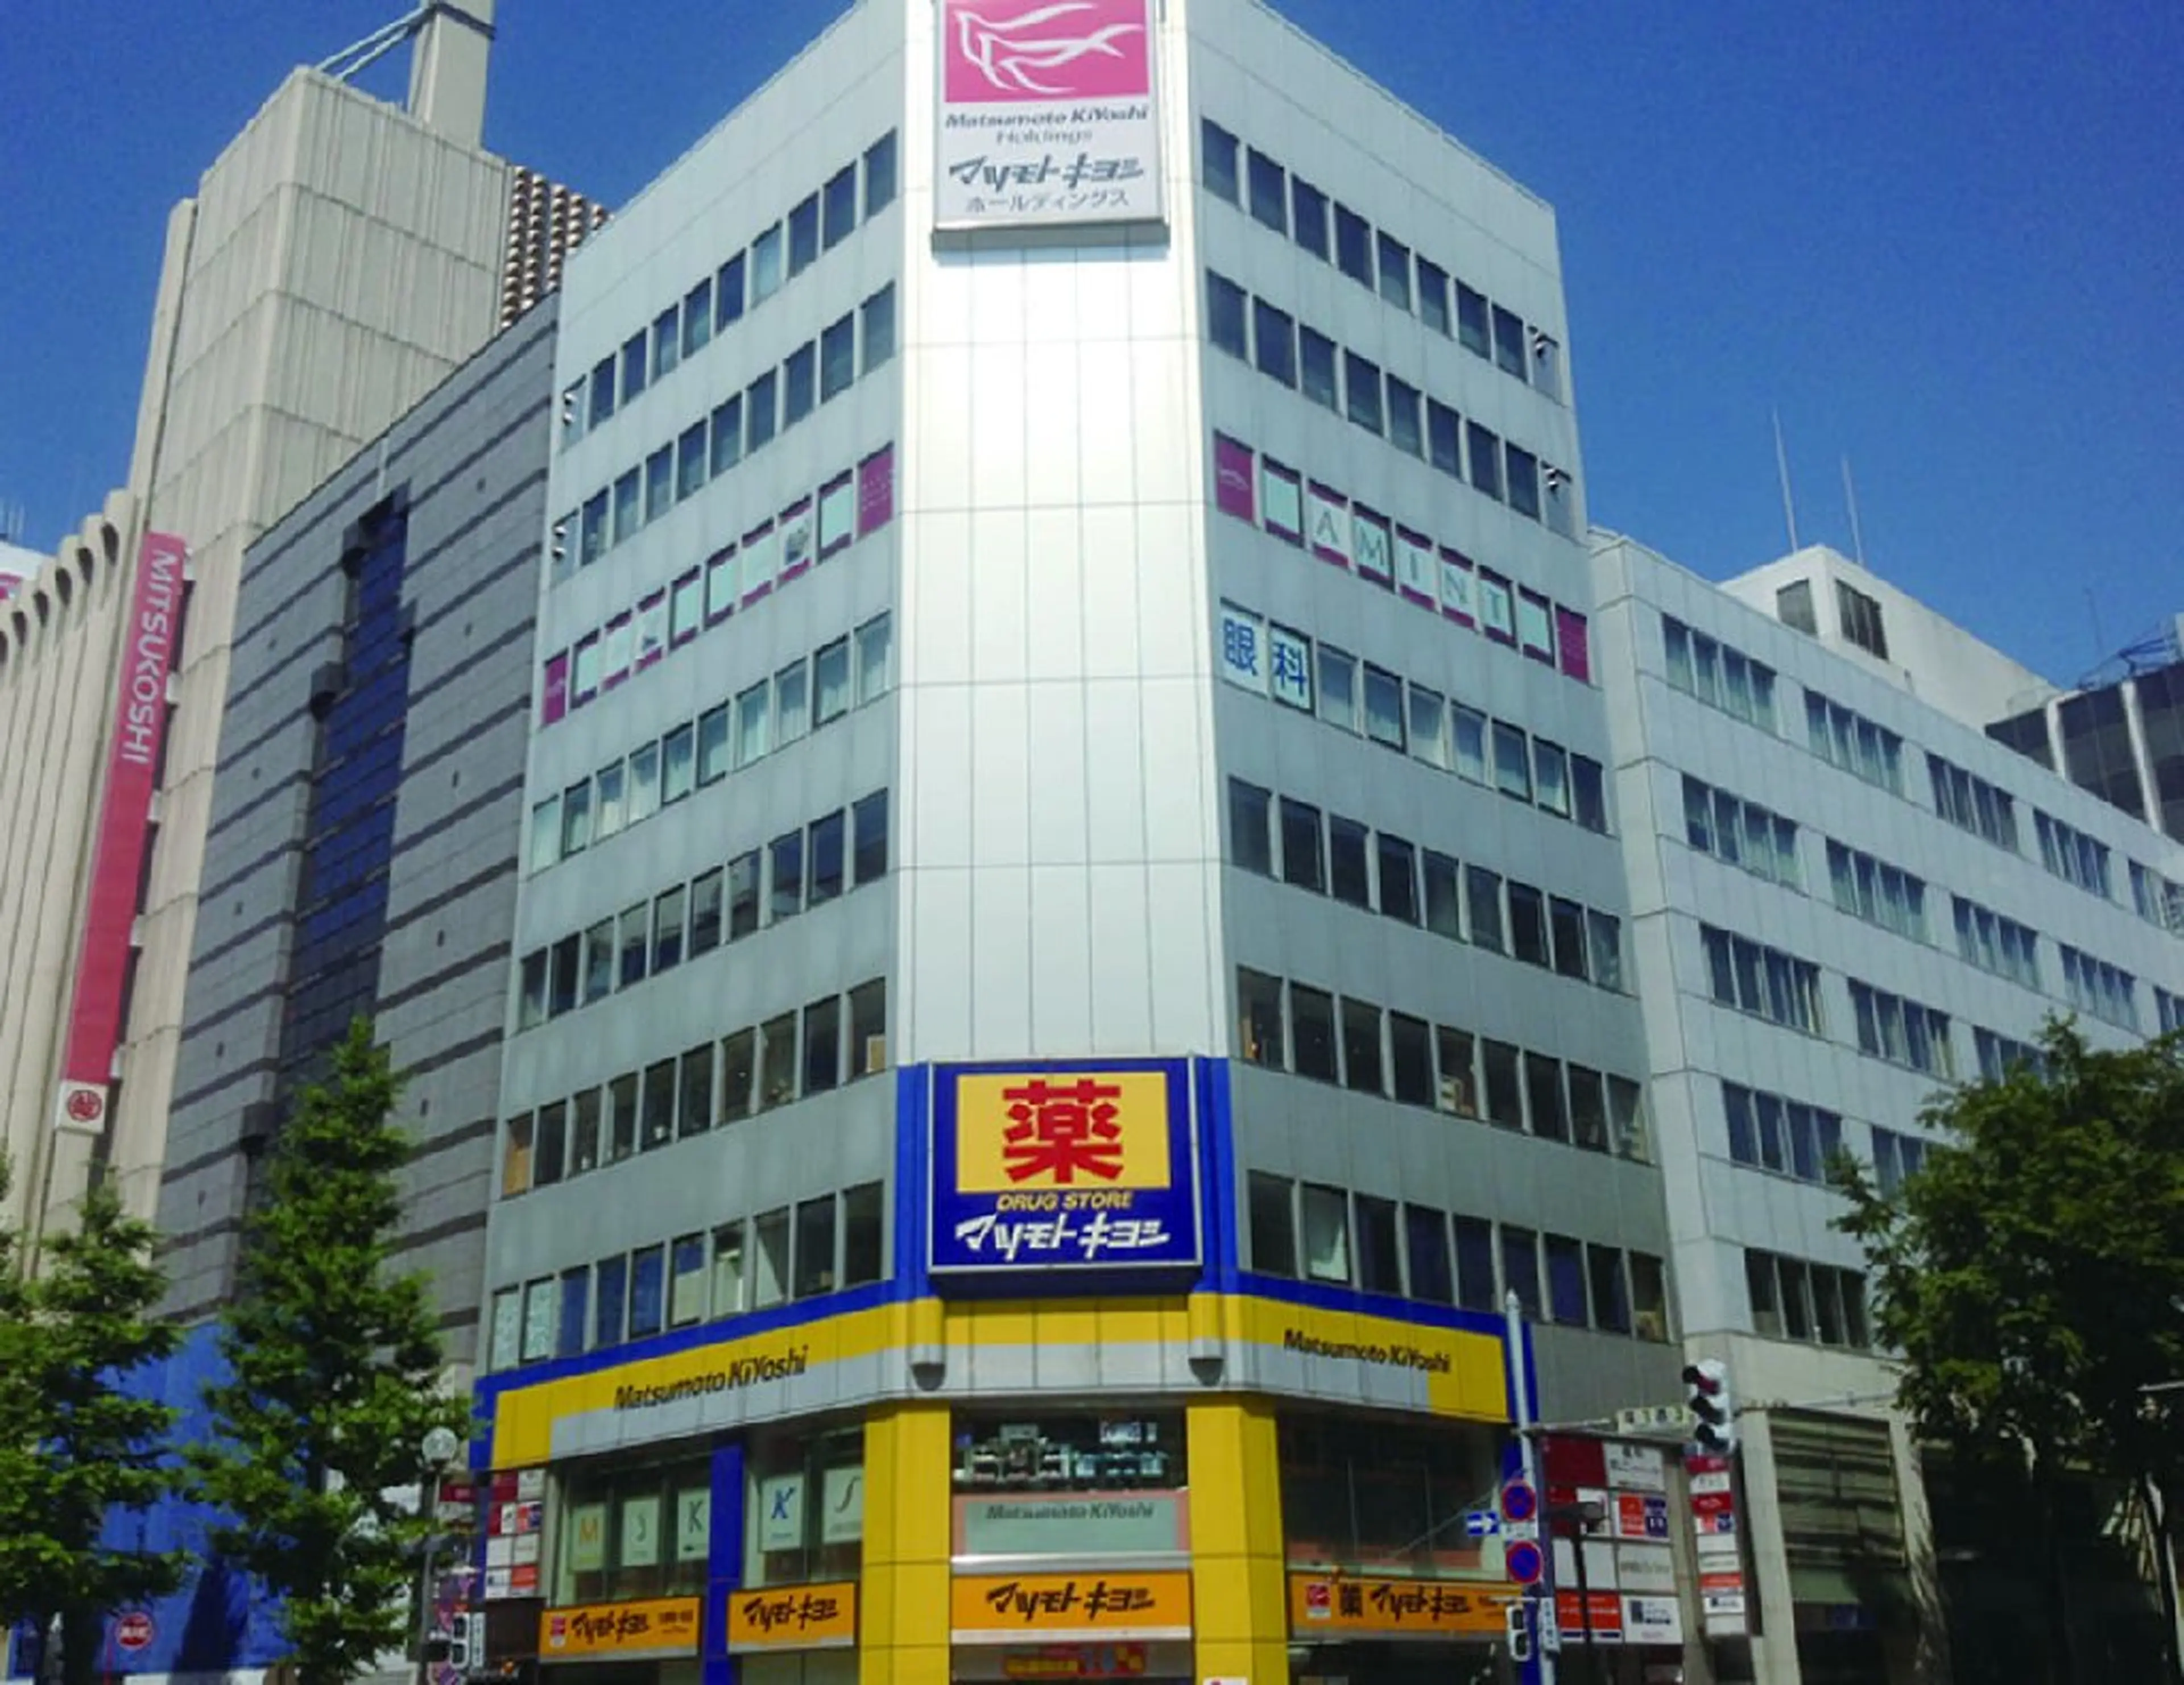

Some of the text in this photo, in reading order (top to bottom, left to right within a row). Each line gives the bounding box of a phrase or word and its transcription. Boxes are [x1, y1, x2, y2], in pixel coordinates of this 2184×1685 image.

[945, 113, 1067, 129] Matsumoto
[949, 152, 1144, 193] マツモトキヨシ
[966, 189, 1130, 213] ホールディングス
[121, 548, 180, 765] MITSUKOSHI
[1222, 617, 1307, 698] 眼科
[1002, 1078, 1124, 1184] 薬
[995, 1191, 1134, 1212] DRUG STORE
[954, 1211, 1172, 1264] マツモトキヨシ
[743, 1593, 840, 1632] マツモトキヨシ
[986, 1581, 1156, 1622] マツモトキヨシ
